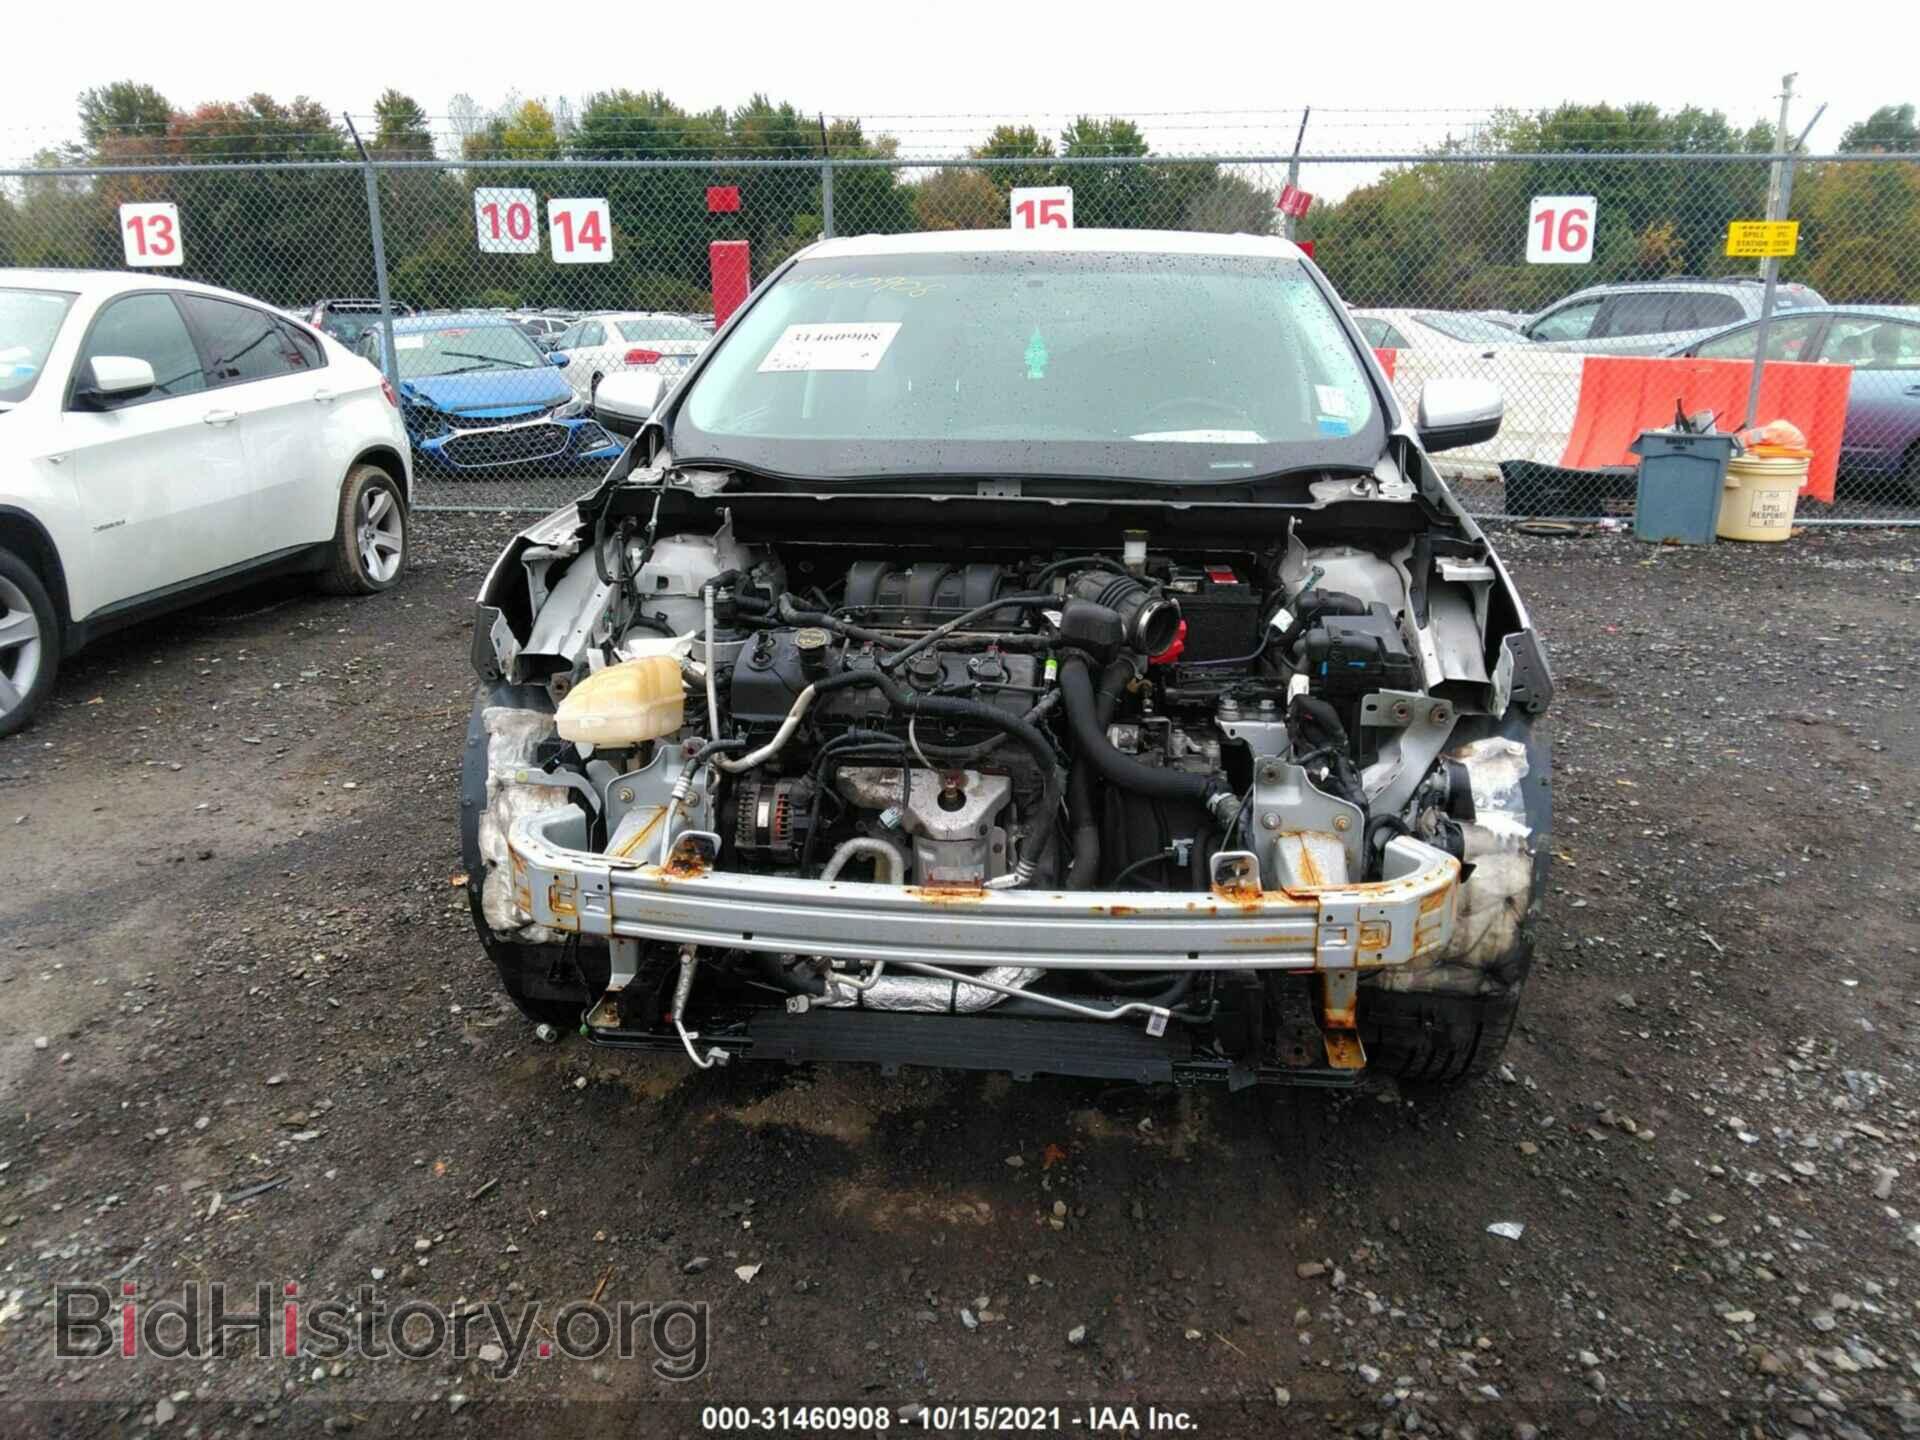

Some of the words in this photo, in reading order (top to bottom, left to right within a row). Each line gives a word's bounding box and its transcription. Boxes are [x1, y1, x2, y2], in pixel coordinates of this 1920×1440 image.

[127, 214, 175, 256] 13
[482, 202, 532, 241] 10
[553, 210, 606, 252] 14
[1016, 199, 1067, 229] 15
[1535, 208, 1589, 252] 16
